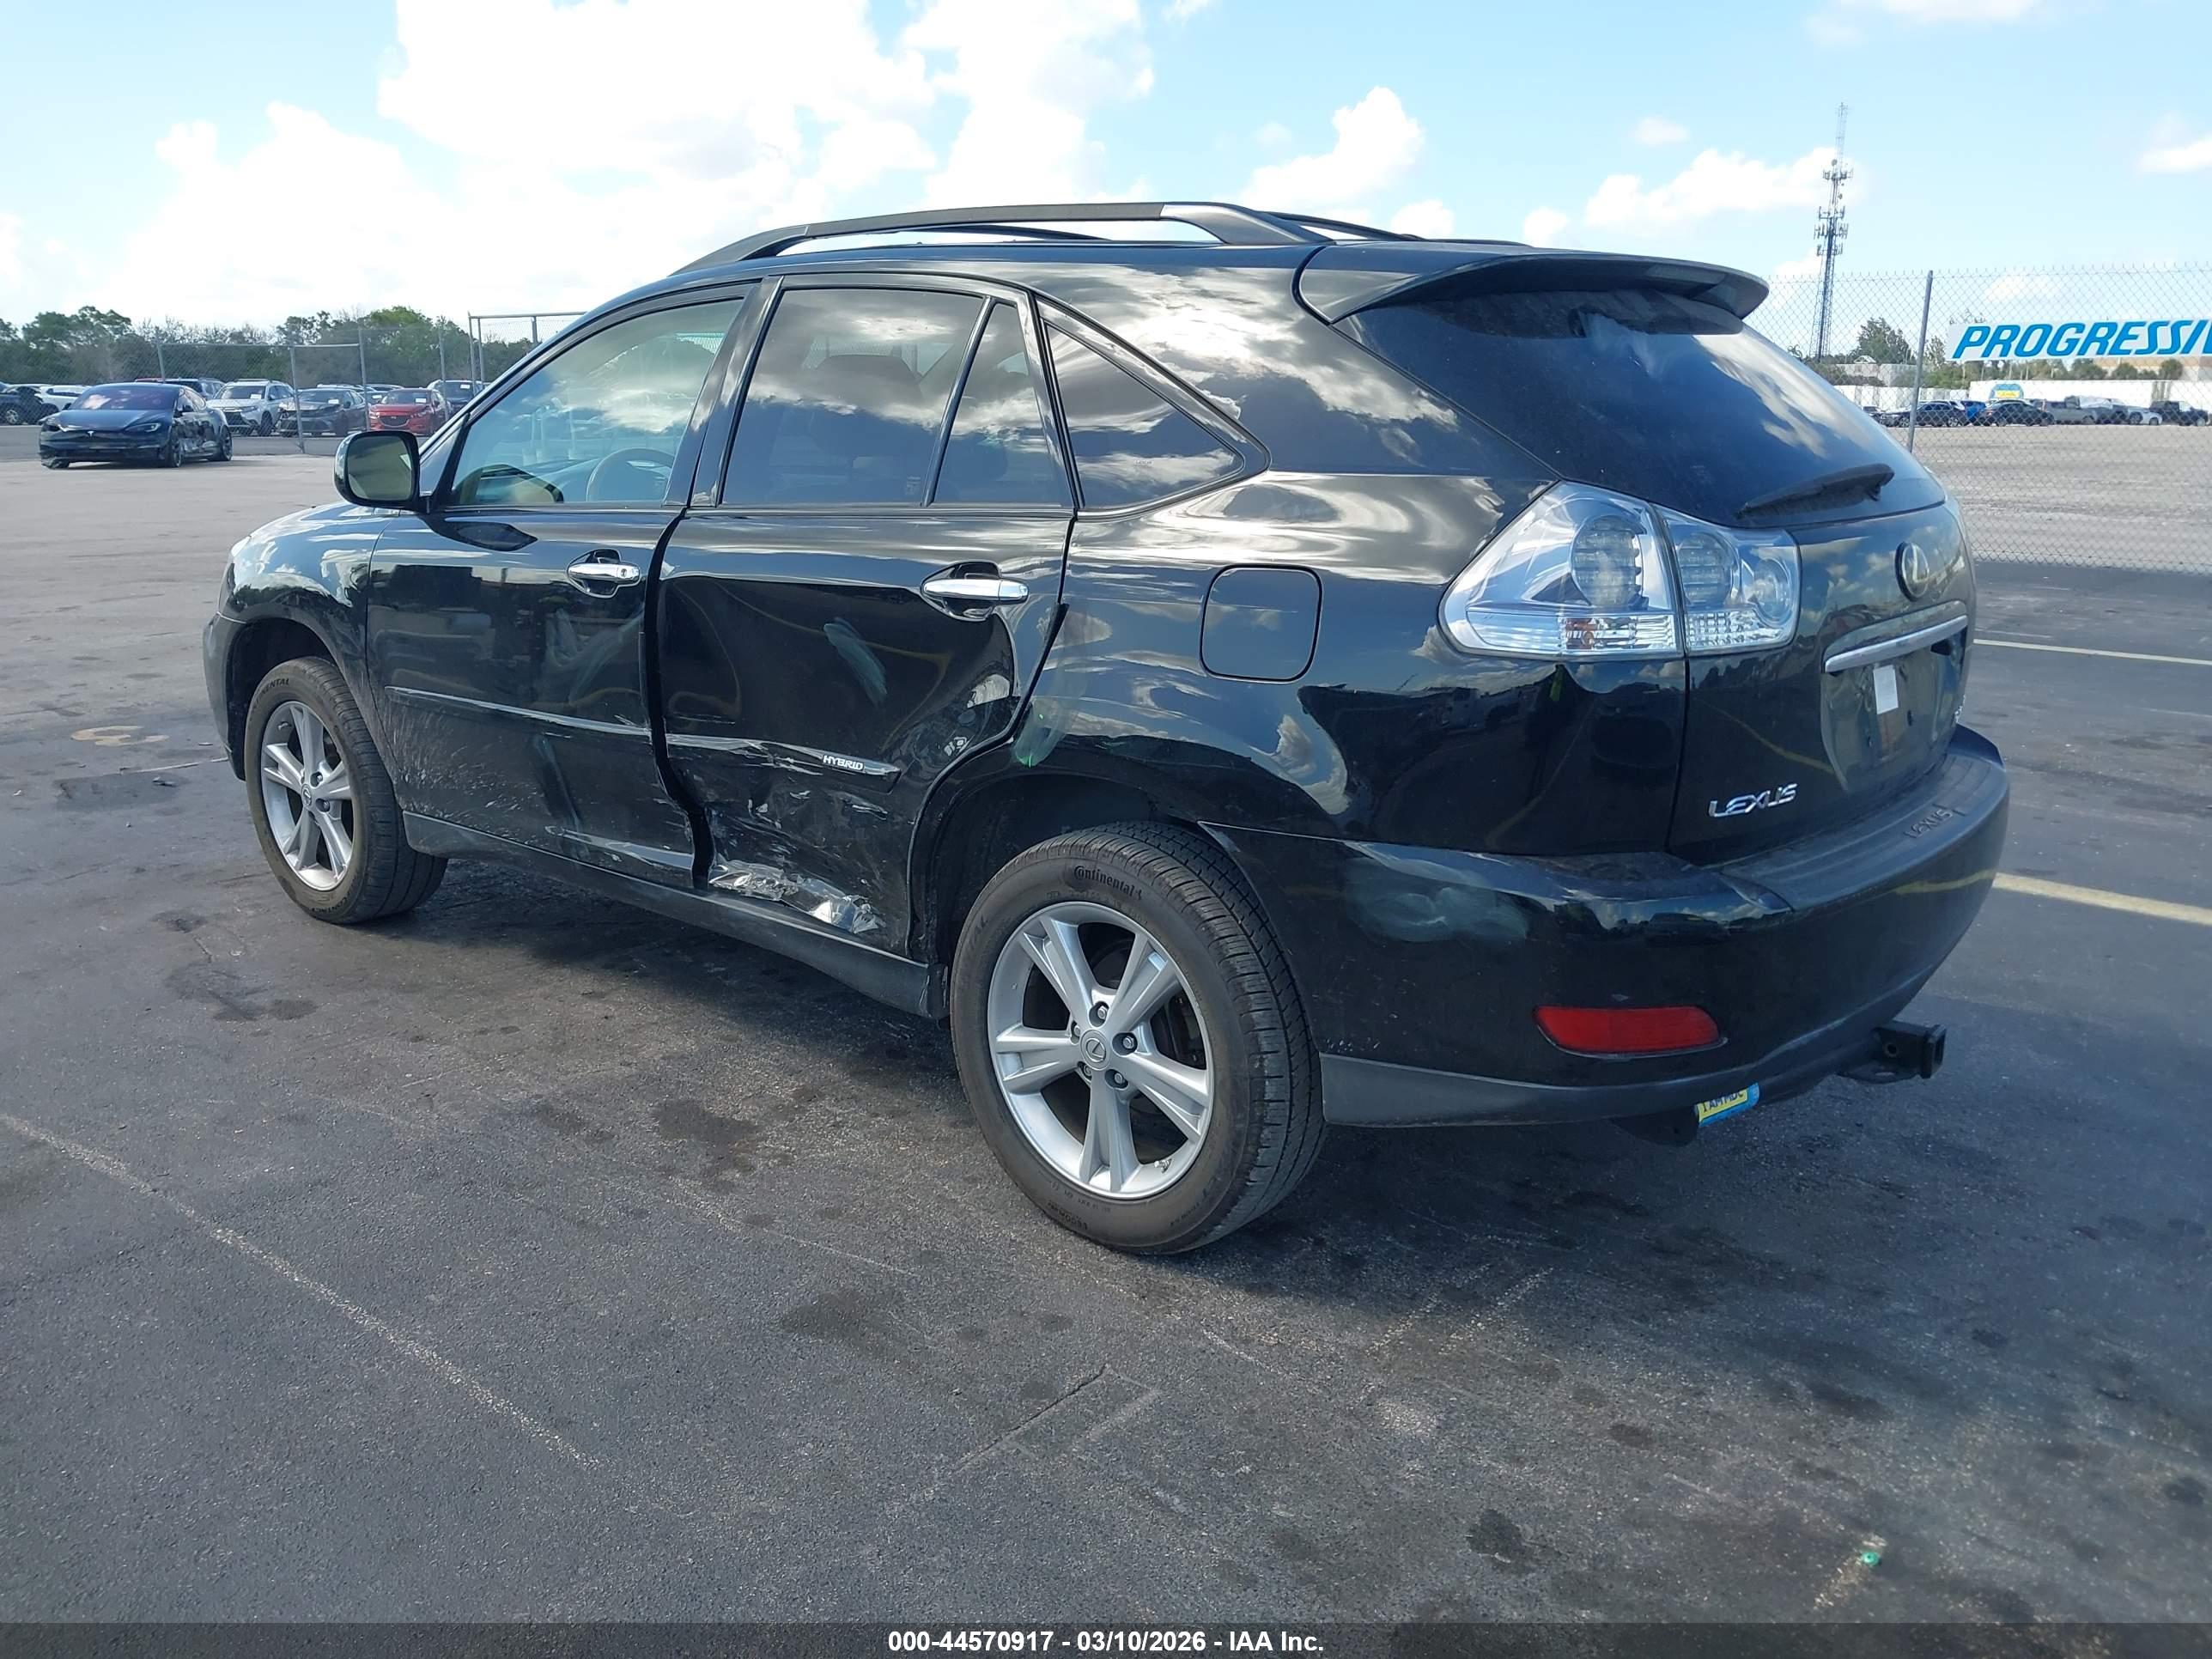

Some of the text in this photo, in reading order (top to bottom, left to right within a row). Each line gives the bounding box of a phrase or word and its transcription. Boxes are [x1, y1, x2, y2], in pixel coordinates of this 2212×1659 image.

[823, 755, 864, 771] HYBRID
[1707, 782, 1798, 817] LEXUS
[1903, 808, 1954, 839] LEXUS
[1073, 865, 1135, 897] Continental
